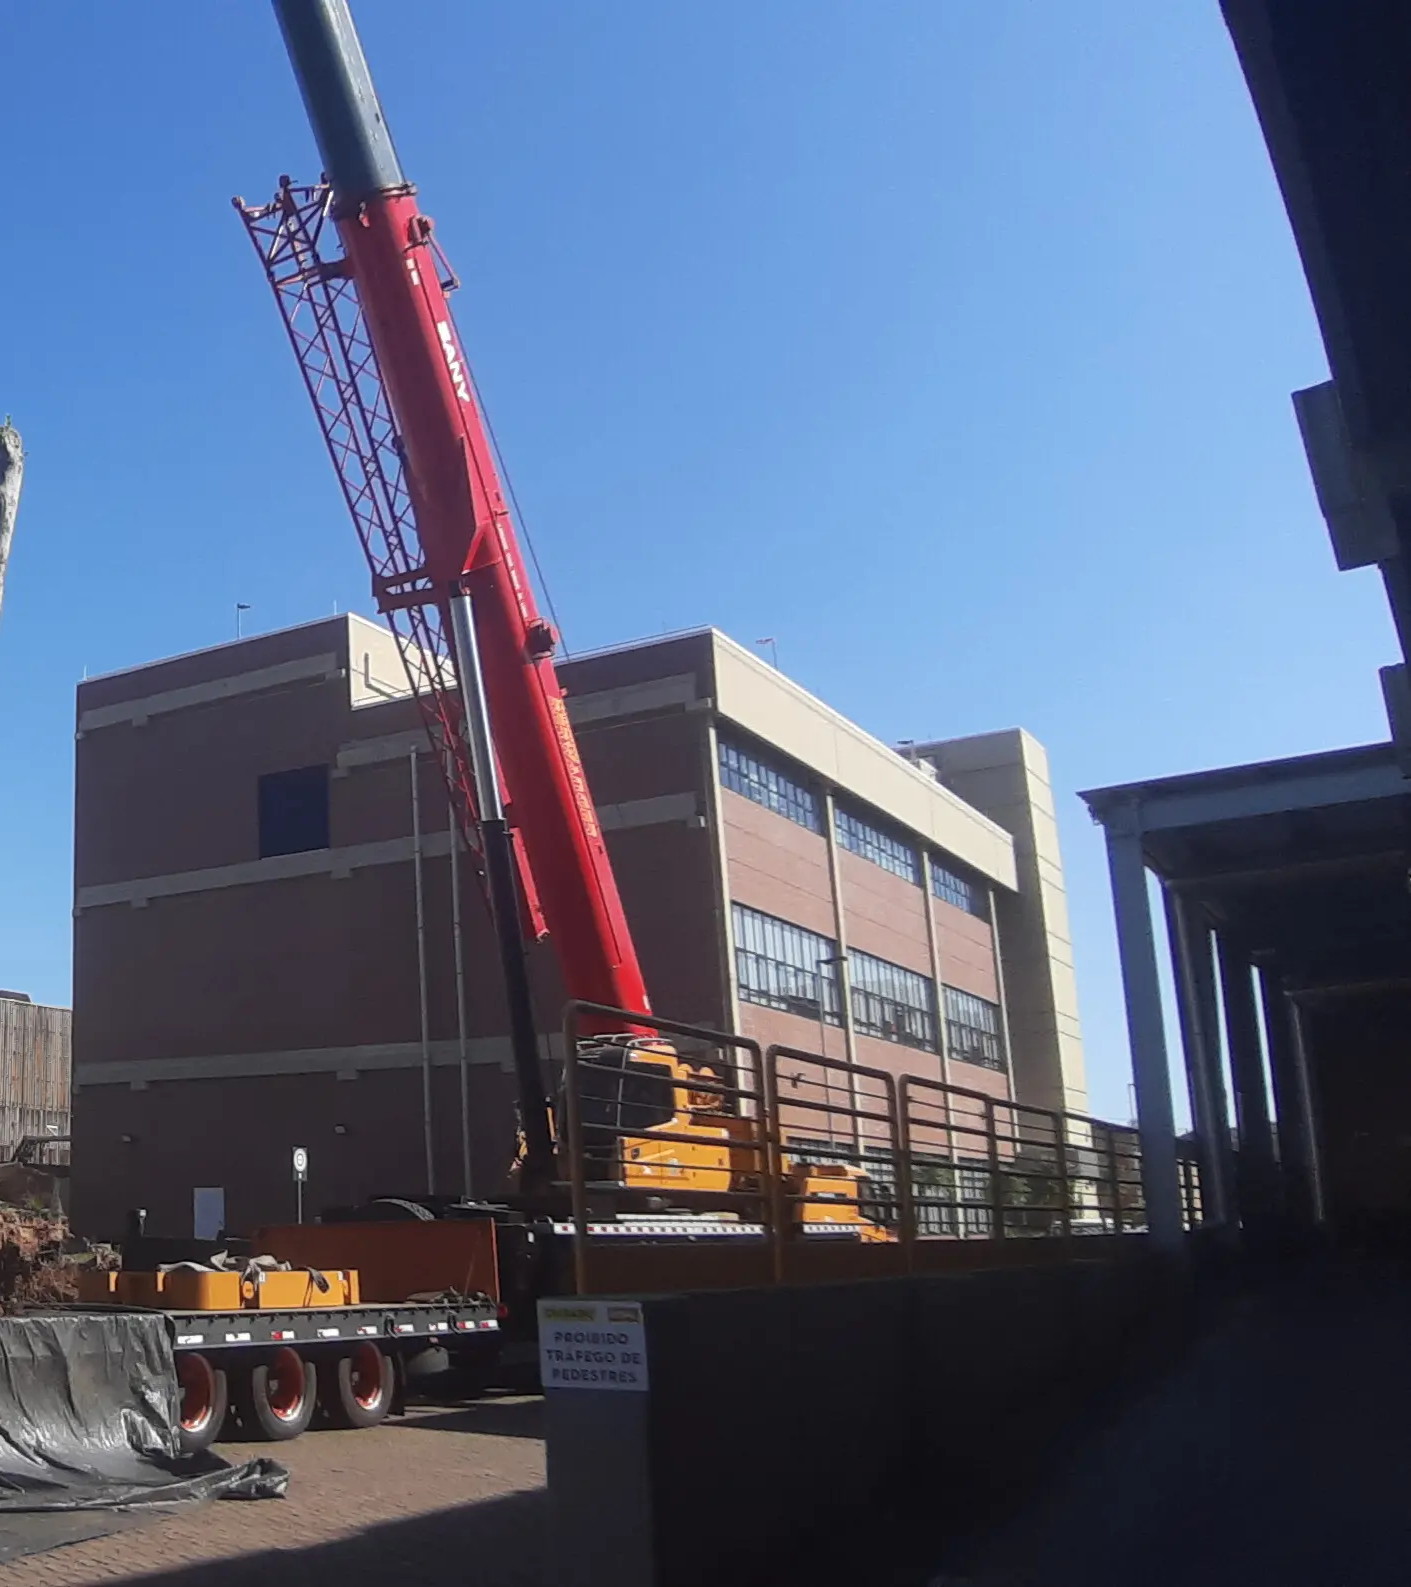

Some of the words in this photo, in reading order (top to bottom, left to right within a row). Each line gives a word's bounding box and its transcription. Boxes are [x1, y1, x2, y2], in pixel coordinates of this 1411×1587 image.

[437, 321, 470, 402] SANY
[554, 1331, 629, 1345] PROIBIDO
[621, 1352, 642, 1365] DE
[552, 1368, 638, 1383] PEDESTRES
